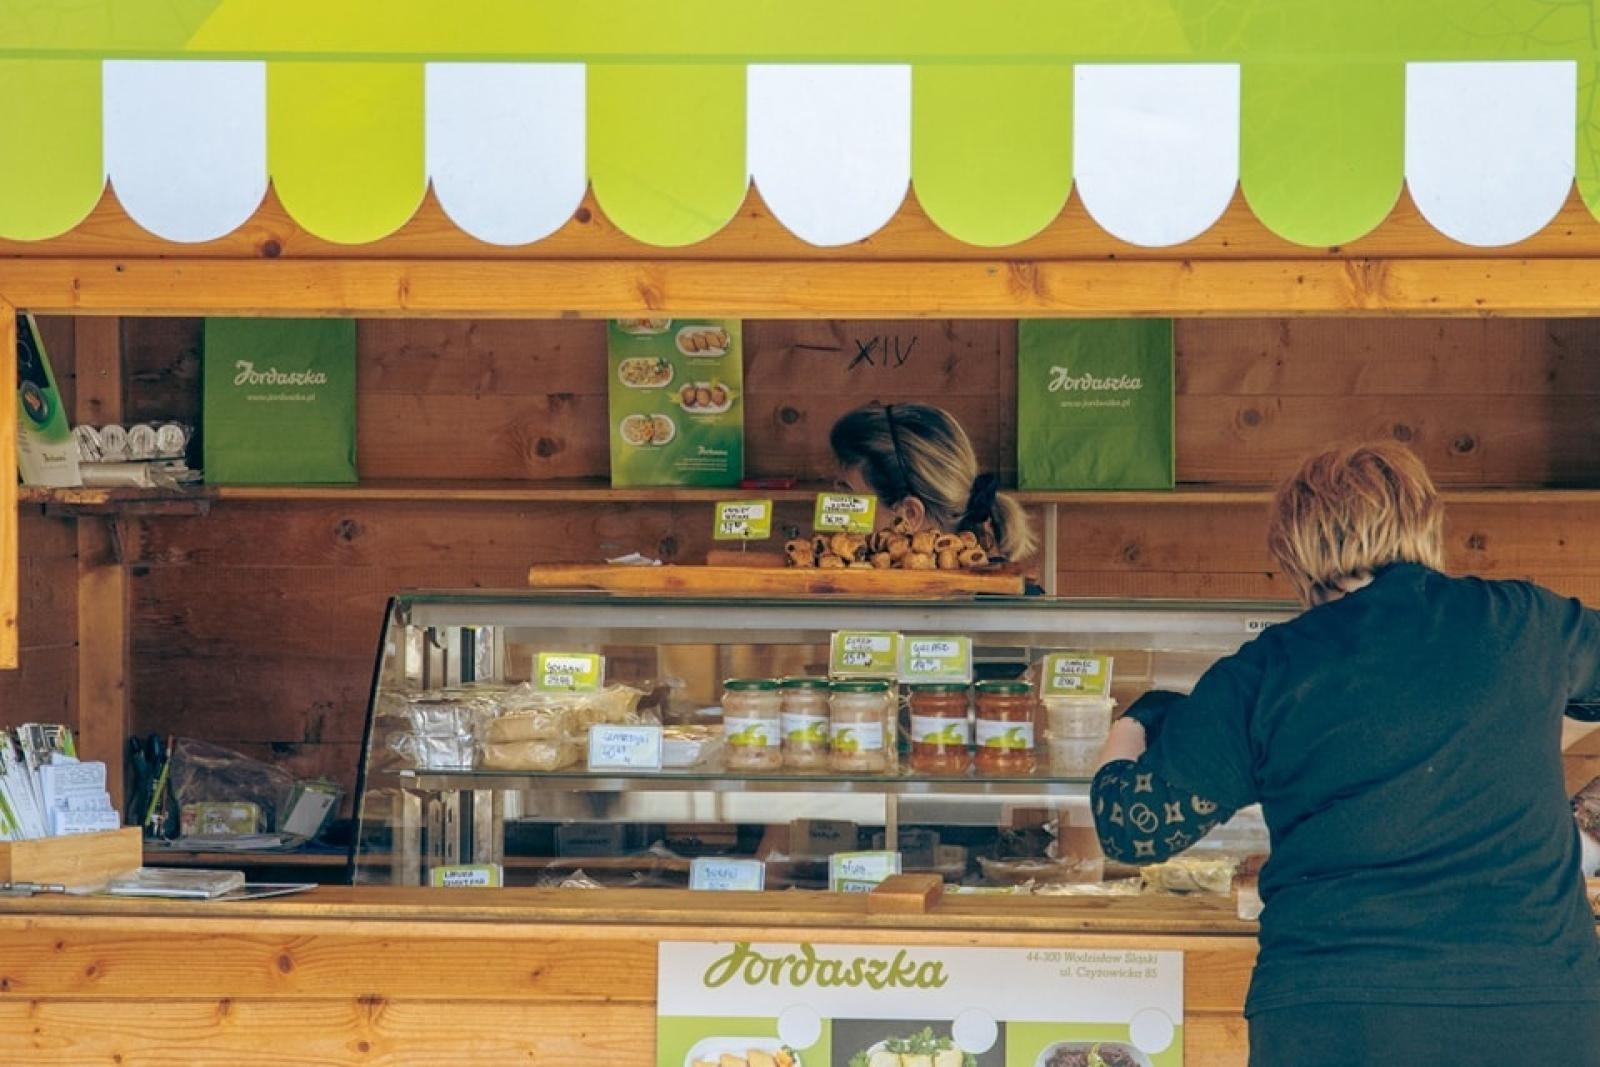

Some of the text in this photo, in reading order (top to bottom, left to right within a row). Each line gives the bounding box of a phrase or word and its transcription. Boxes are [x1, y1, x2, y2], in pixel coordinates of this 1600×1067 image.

[234, 359, 328, 386] Jordaszka
[1047, 366, 1143, 392] Jordaszka
[703, 942, 949, 990] Jordaszka
[1026, 952, 1061, 962] 44-300
[1059, 967, 1072, 977] ul.
